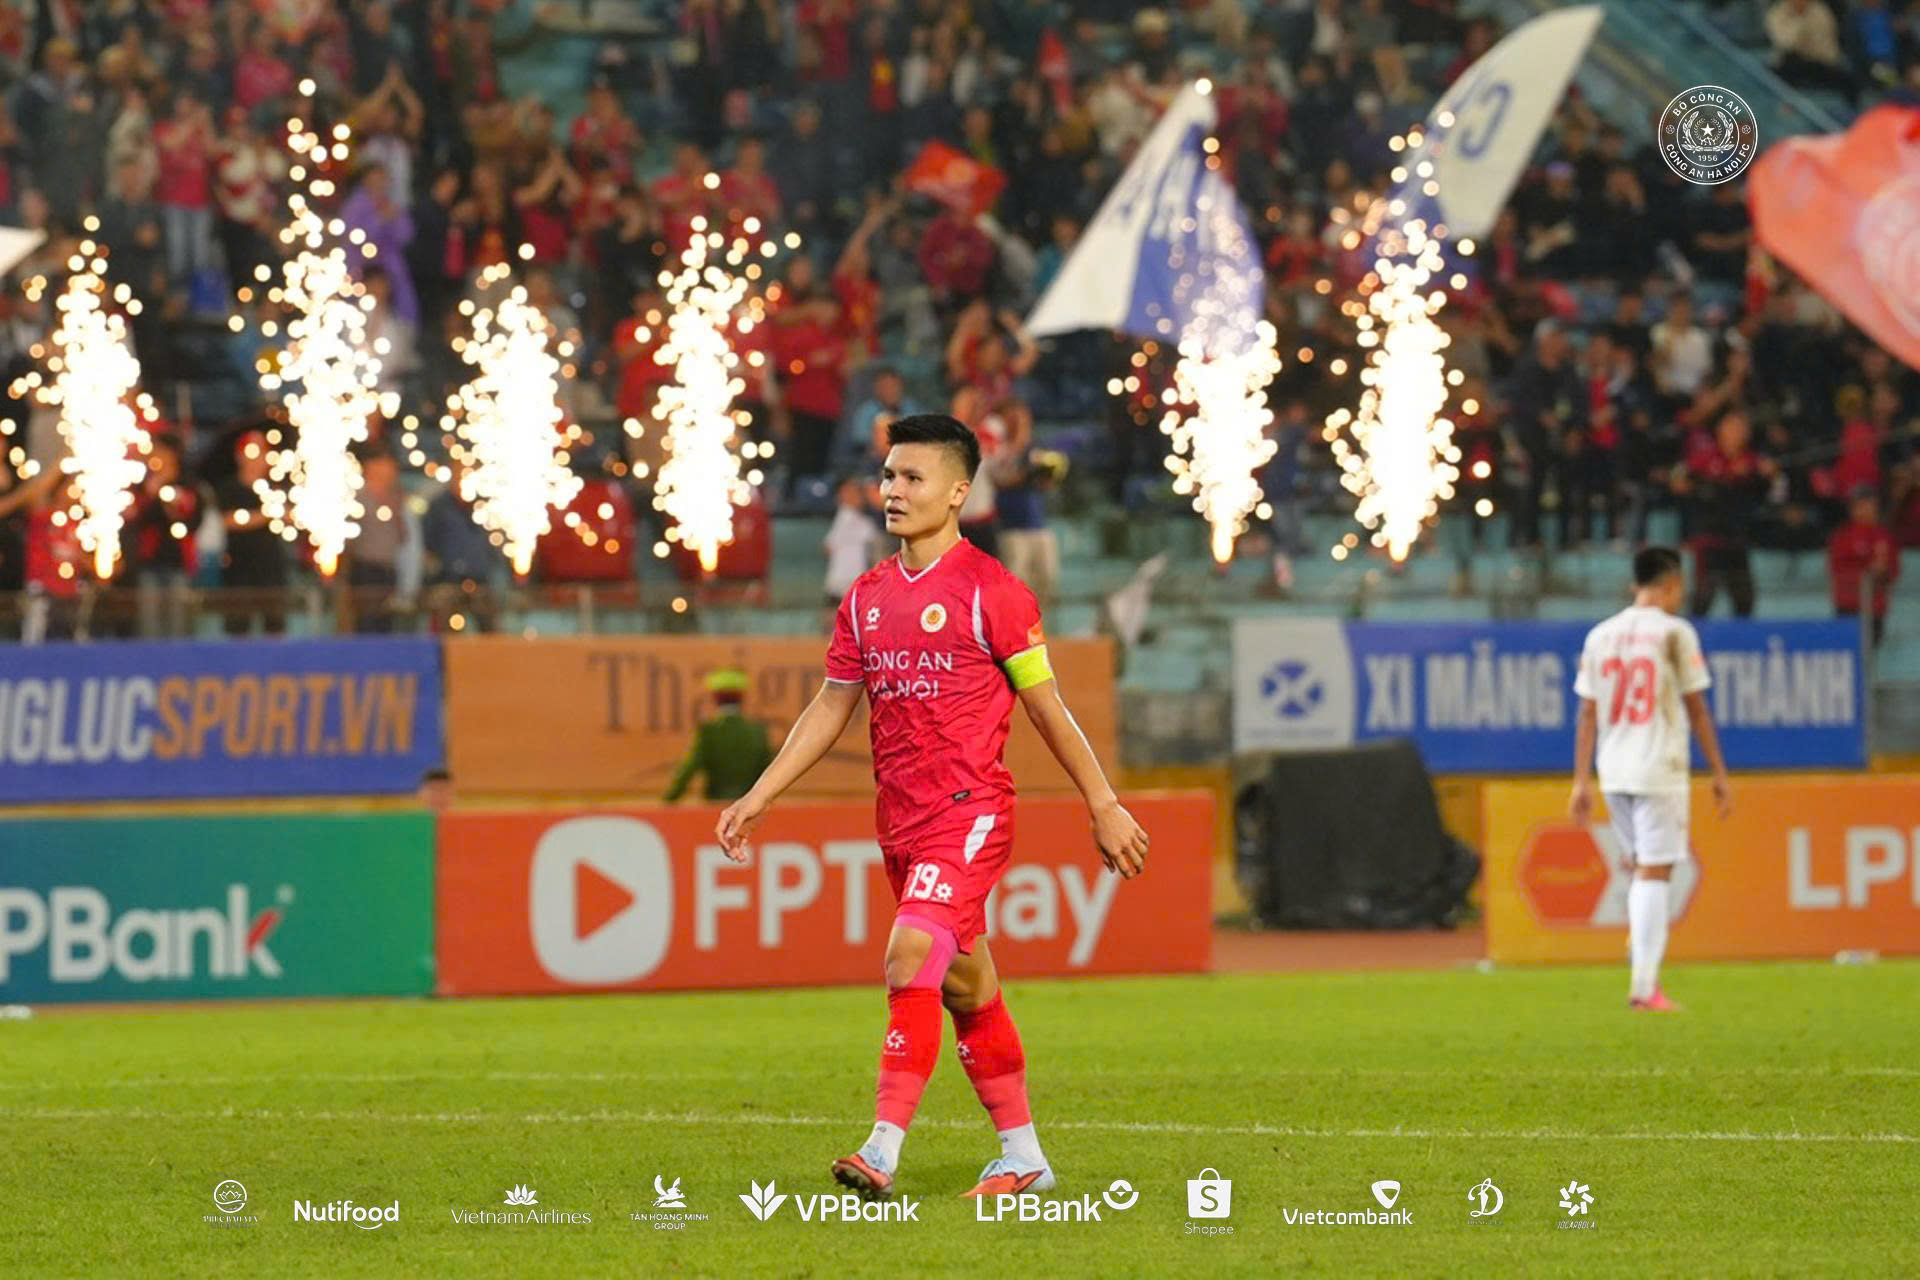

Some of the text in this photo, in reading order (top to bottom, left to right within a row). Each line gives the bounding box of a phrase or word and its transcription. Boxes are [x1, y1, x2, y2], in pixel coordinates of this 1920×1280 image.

[917, 651, 953, 671] AN
[694, 842, 883, 950] FPT
[907, 863, 941, 899] 19
[1788, 825, 1920, 909] LP
